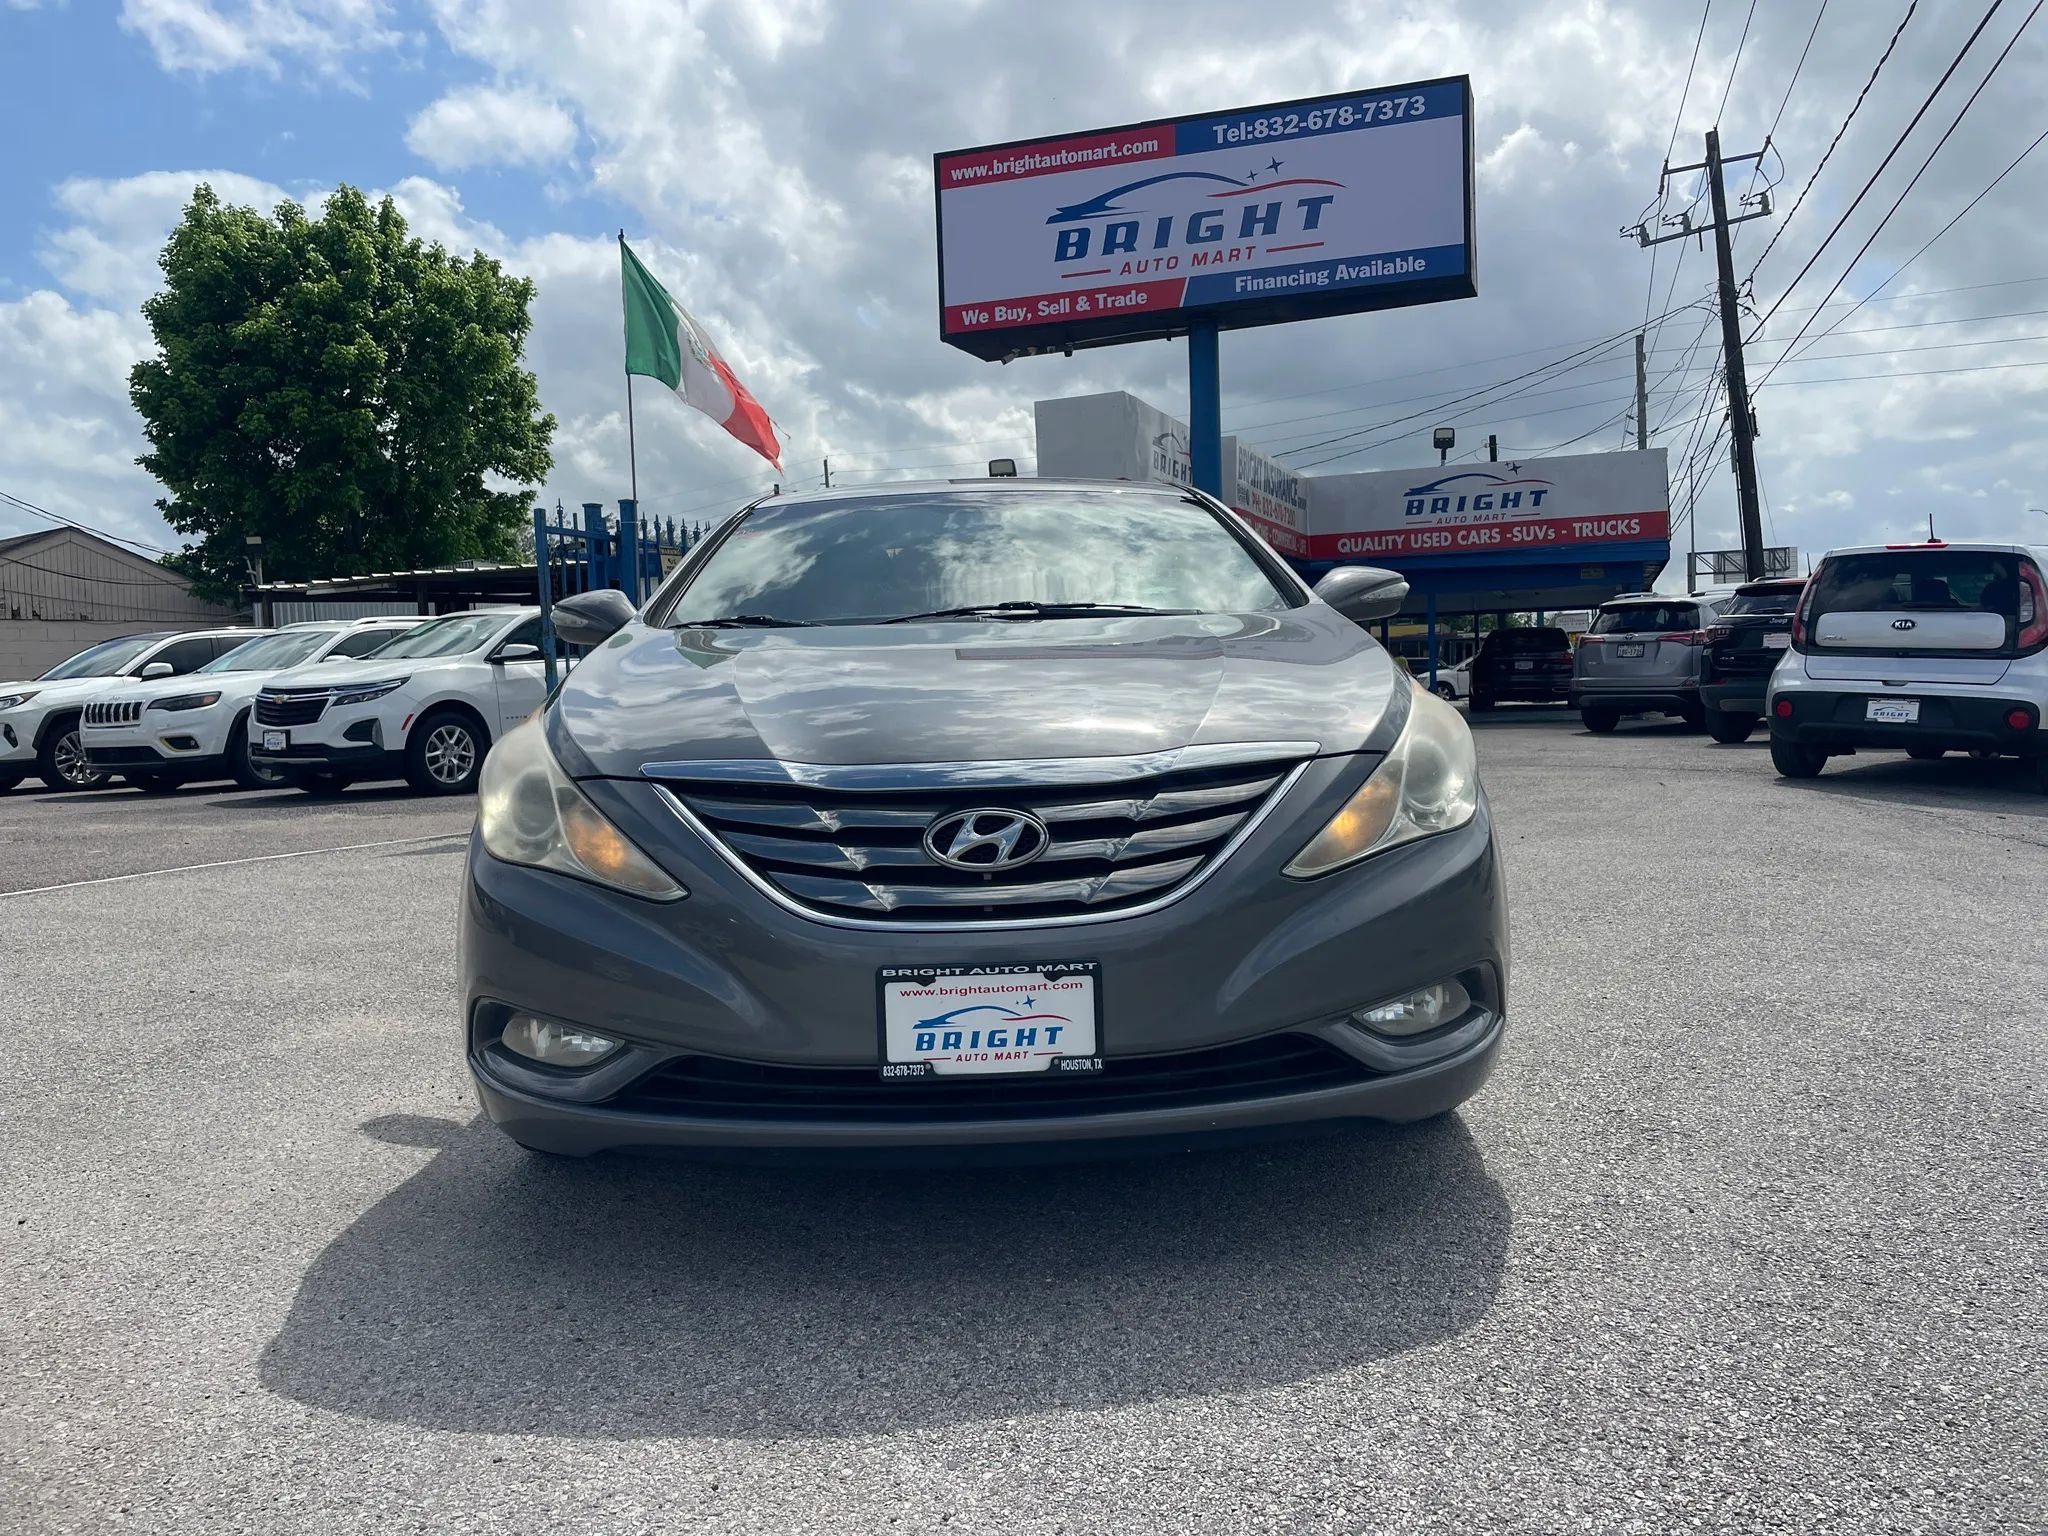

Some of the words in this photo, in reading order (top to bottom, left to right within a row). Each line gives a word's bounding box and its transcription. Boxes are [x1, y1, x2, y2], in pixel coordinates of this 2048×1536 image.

[1213, 95, 1426, 144] Tel:832-678-7373
[951, 138, 1158, 181] www.brightautomart.com
[1054, 195, 1334, 262] BRIGHT
[1120, 256, 1179, 275] AUTO
[1191, 246, 1256, 267] MART
[1235, 269, 1330, 293] Financing
[1335, 256, 1426, 281] Available
[962, 310, 989, 326] We
[994, 306, 1032, 322] Buy,
[1037, 298, 1070, 317] Sell
[1076, 295, 1091, 312] &
[1095, 290, 1148, 309] Trade
[1405, 490, 1548, 516] BRIGHT
[1436, 516, 1467, 525] AUTO
[1473, 513, 1507, 523] MART
[1337, 534, 1405, 553] QUALITY
[1410, 531, 1452, 548] USED
[1457, 528, 1500, 545] CARS
[1572, 519, 1641, 538] TRUCKS
[1894, 620, 1912, 629] KIA
[882, 967, 965, 977] BRIGHT
[969, 966, 1029, 975] AUTO
[1036, 962, 1098, 973] MART
[900, 981, 1083, 998] www.brightautomart.com
[915, 1026, 1063, 1051] BRIGHT
[956, 1052, 988, 1063] AUTO
[994, 1050, 1029, 1061] MART
[1060, 1059, 1093, 1071] HOUSTON,
[1094, 1058, 1103, 1070] TX
[883, 1065, 925, 1077] 832-678-7373
